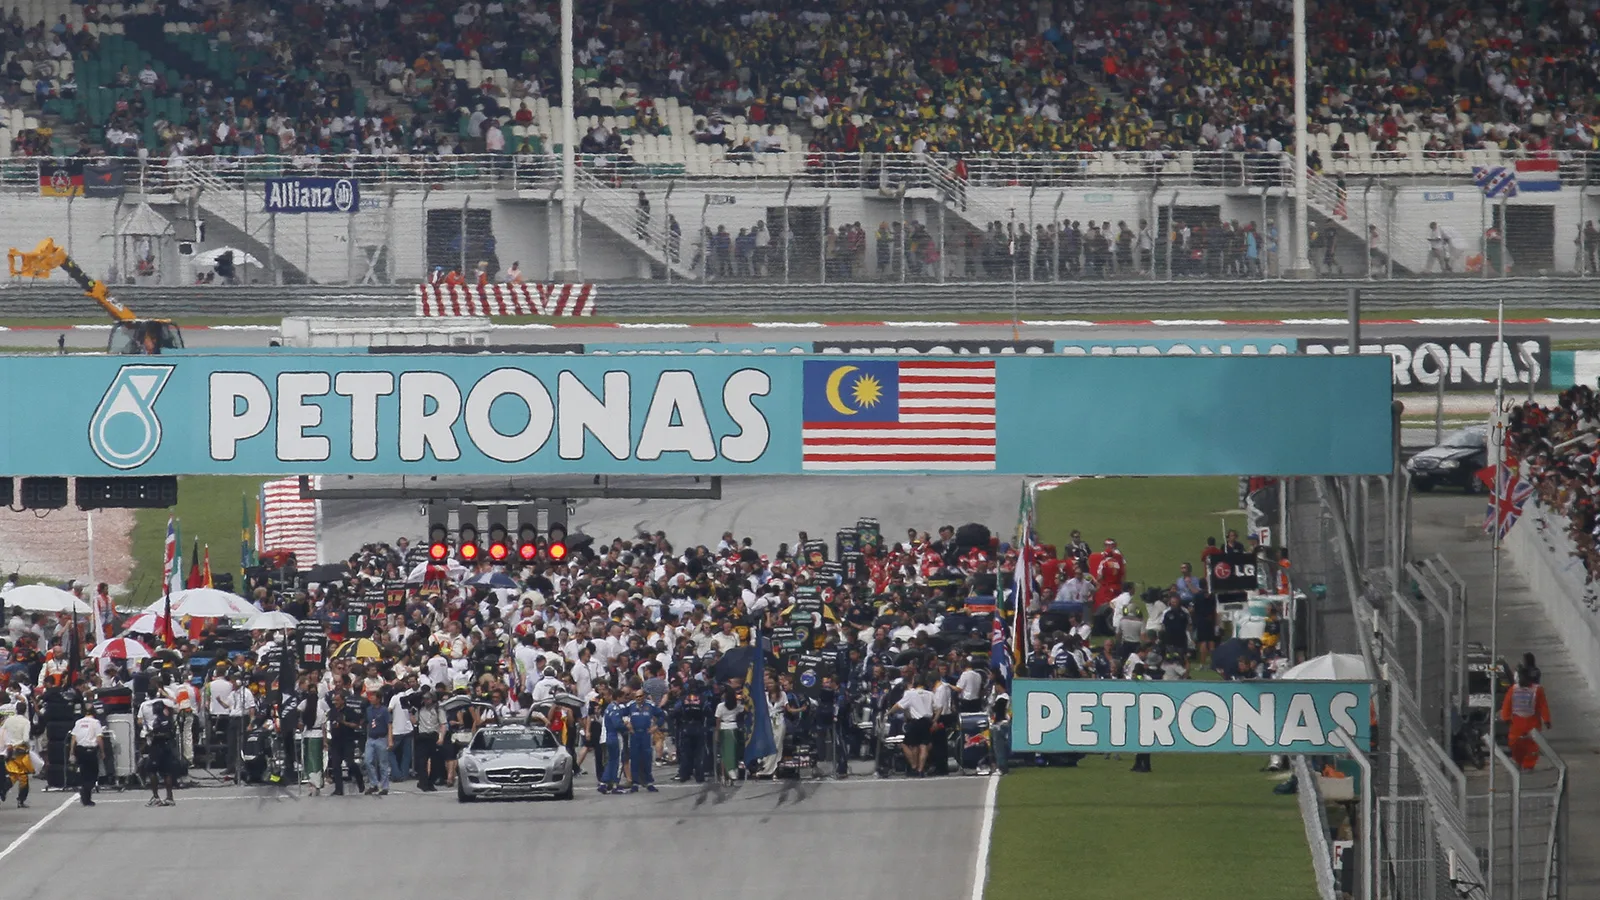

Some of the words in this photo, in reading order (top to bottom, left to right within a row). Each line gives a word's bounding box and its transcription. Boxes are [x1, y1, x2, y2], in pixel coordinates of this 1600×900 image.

[269, 181, 332, 208] Allianz
[1306, 341, 1541, 385] RONAS
[209, 368, 770, 464] PETRONAS
[1234, 564, 1255, 577] LG
[1026, 691, 1359, 747] PETRONAS
